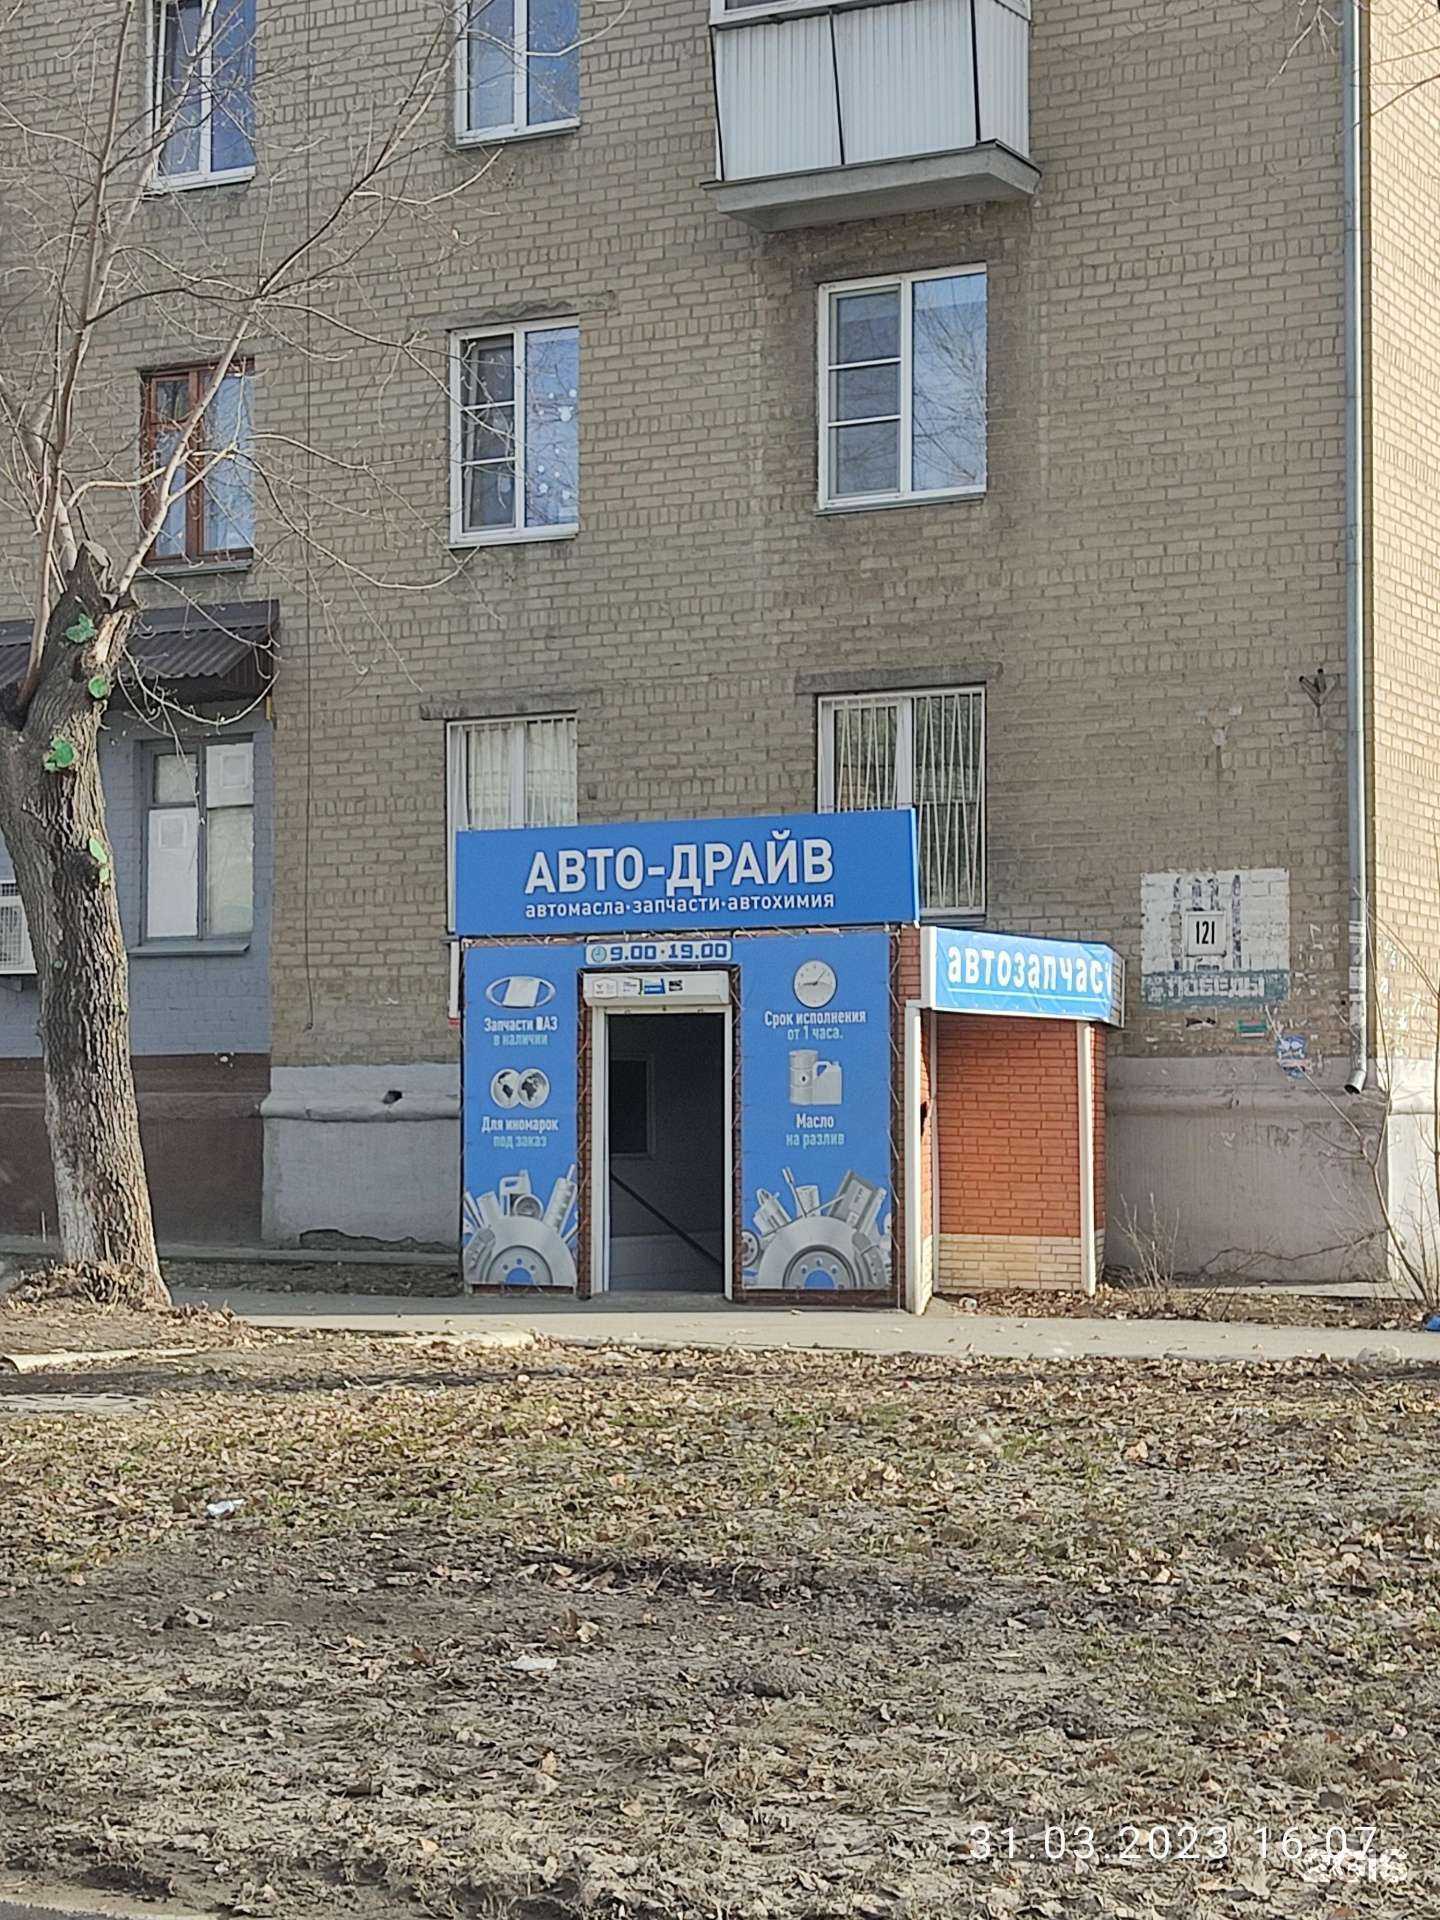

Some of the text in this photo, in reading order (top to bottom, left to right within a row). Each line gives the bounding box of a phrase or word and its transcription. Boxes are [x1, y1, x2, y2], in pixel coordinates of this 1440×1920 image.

[524, 829, 834, 896] АВТО-ДРАЙВ
[1195, 920, 1216, 945] 121
[610, 943, 728, 961] 9.00 19.00
[484, 1017, 534, 1032] Запчасти
[764, 1010, 866, 1029] Срок исполнения
[787, 1028, 800, 1040] от
[803, 1025, 809, 1040] 1
[481, 1116, 559, 1134] Для иномарок
[796, 1113, 835, 1129] Масло
[493, 1135, 547, 1149] под заказ
[786, 1133, 845, 1149] на разлив
